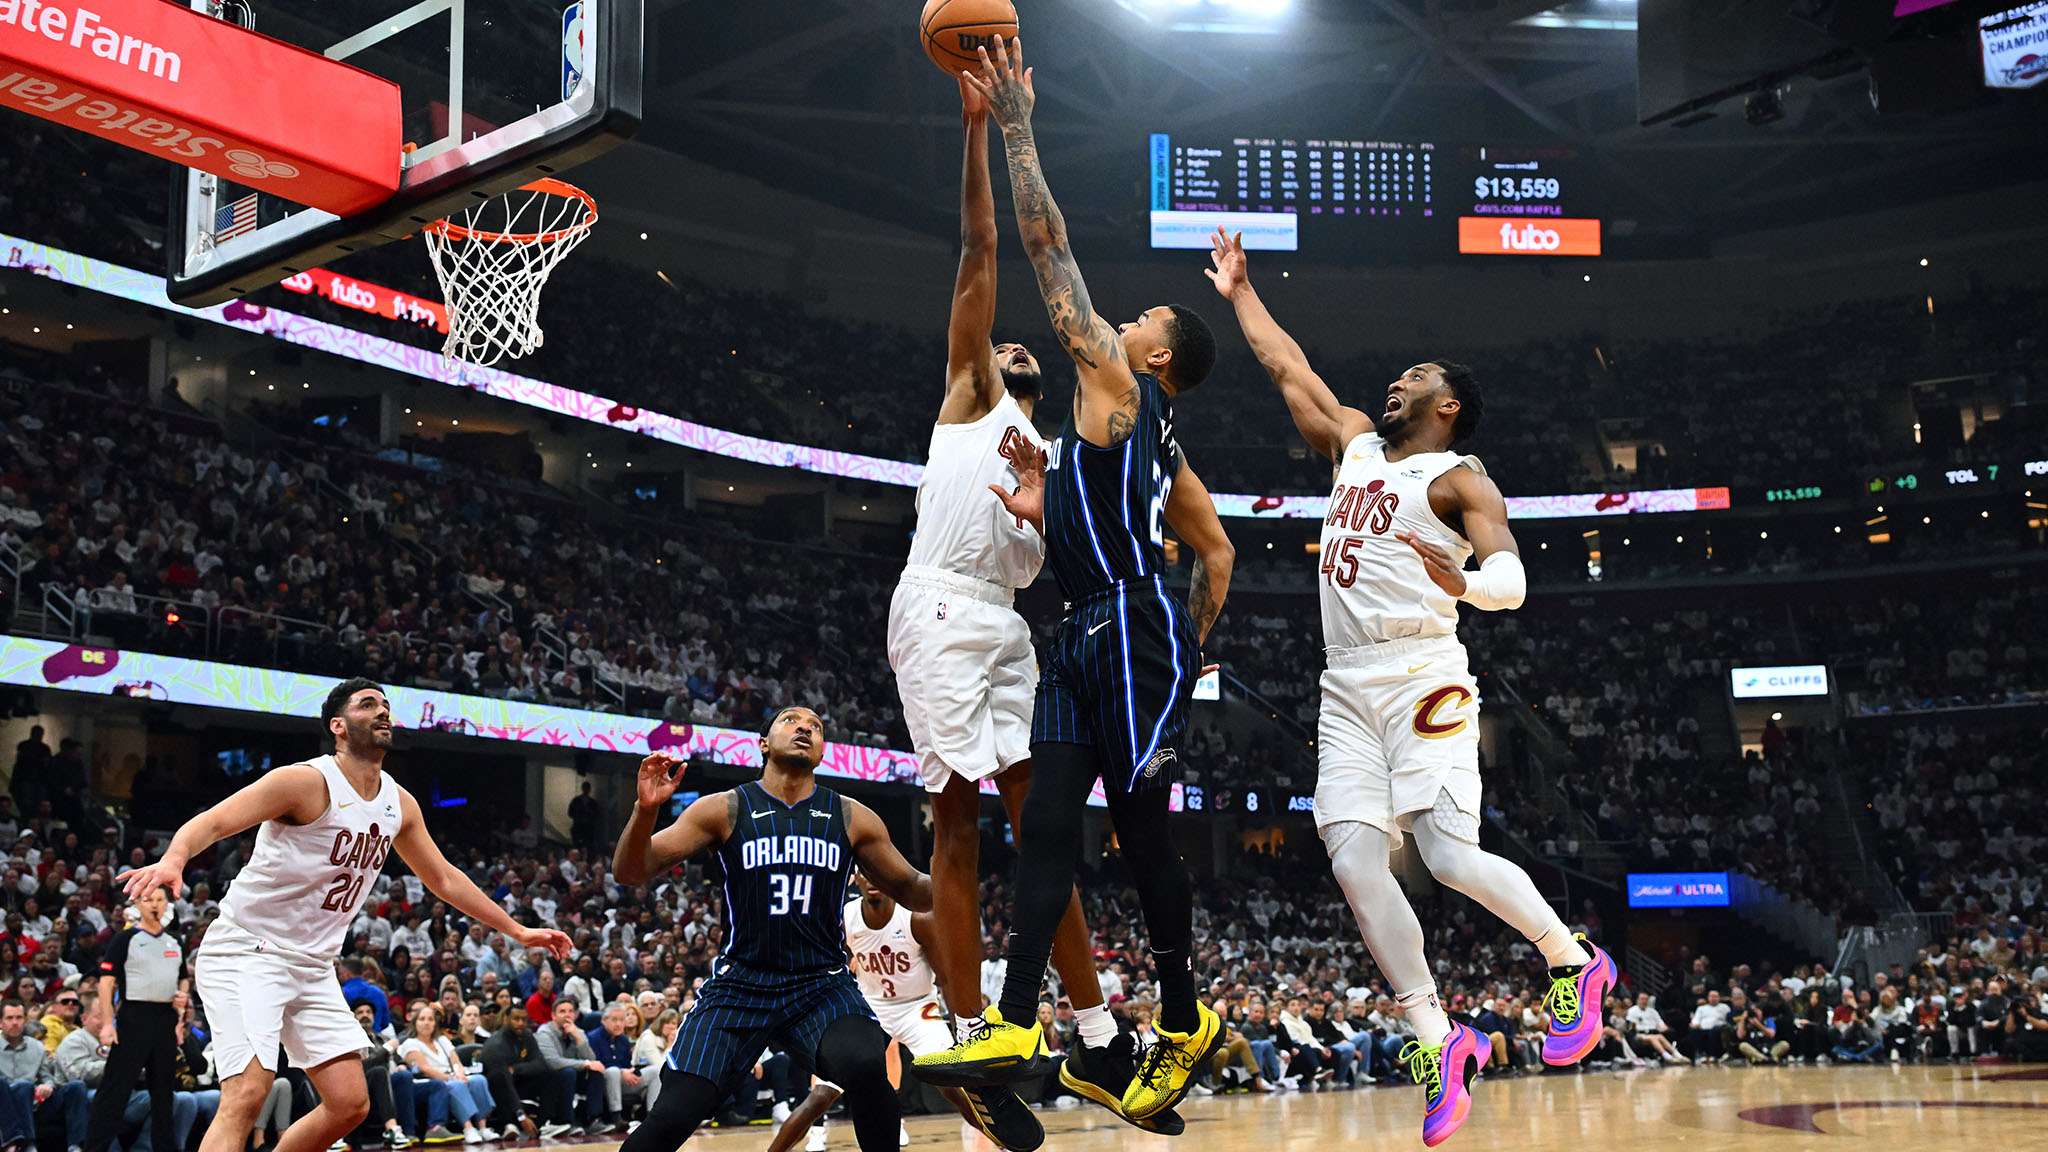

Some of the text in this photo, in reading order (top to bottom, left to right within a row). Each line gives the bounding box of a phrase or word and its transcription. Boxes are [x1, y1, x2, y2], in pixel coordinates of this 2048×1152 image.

[1989, 28, 2048, 55] CHAMPIO
[75, 100, 225, 158] State
[1475, 176, 1560, 201] $13,559
[1500, 223, 1561, 251] fubo
[331, 277, 376, 308] fubo
[1945, 465, 1999, 484] TOL 7
[1326, 480, 1400, 535] CAVS
[1321, 536, 1364, 589] 45
[1187, 796, 1203, 810] 62
[1246, 792, 1258, 812] 8
[329, 823, 391, 870] CAVS
[742, 835, 841, 872] ORLANDO
[320, 873, 364, 913] 20
[769, 873, 813, 915] 34
[1681, 883, 1723, 896] ULTRA
[856, 945, 911, 975] CAVS
[881, 978, 896, 998] 3
